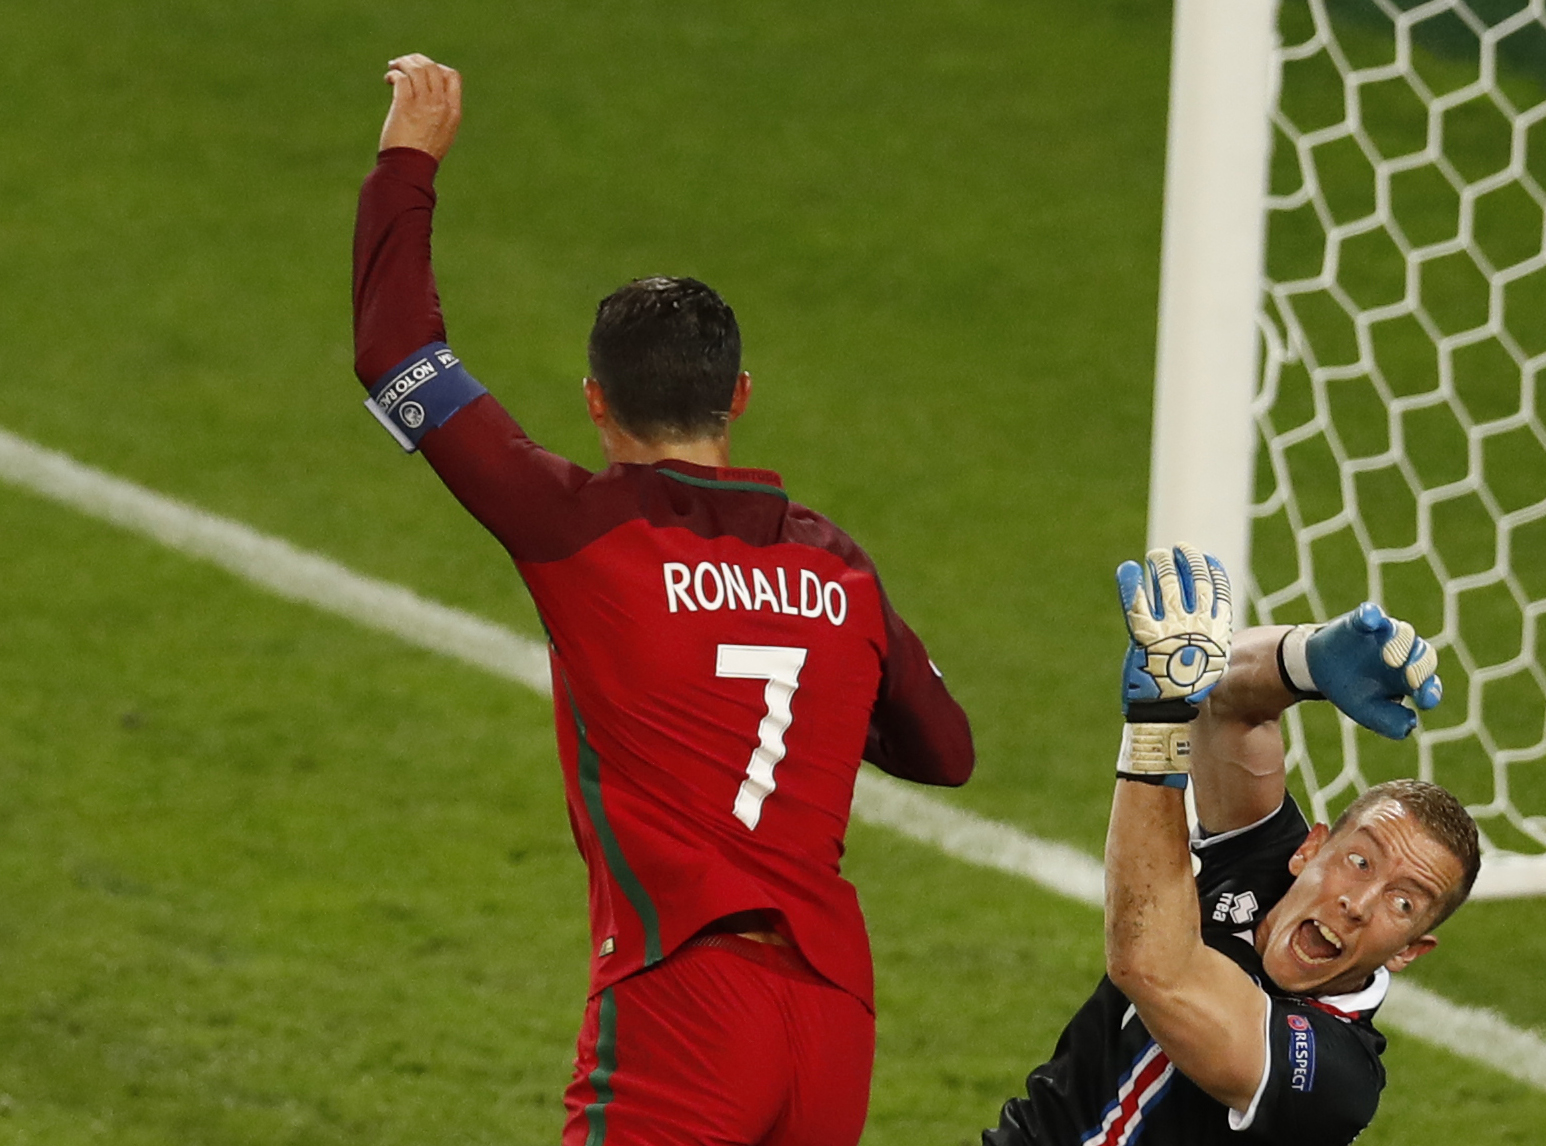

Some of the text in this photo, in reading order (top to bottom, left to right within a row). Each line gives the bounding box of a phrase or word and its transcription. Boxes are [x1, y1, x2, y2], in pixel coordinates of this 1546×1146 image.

[395, 375, 416, 393] TO
[412, 361, 436, 380] NO
[663, 561, 847, 626] RONALDO
[715, 643, 808, 831] 7
[1291, 1031, 1309, 1091] RESPECT
